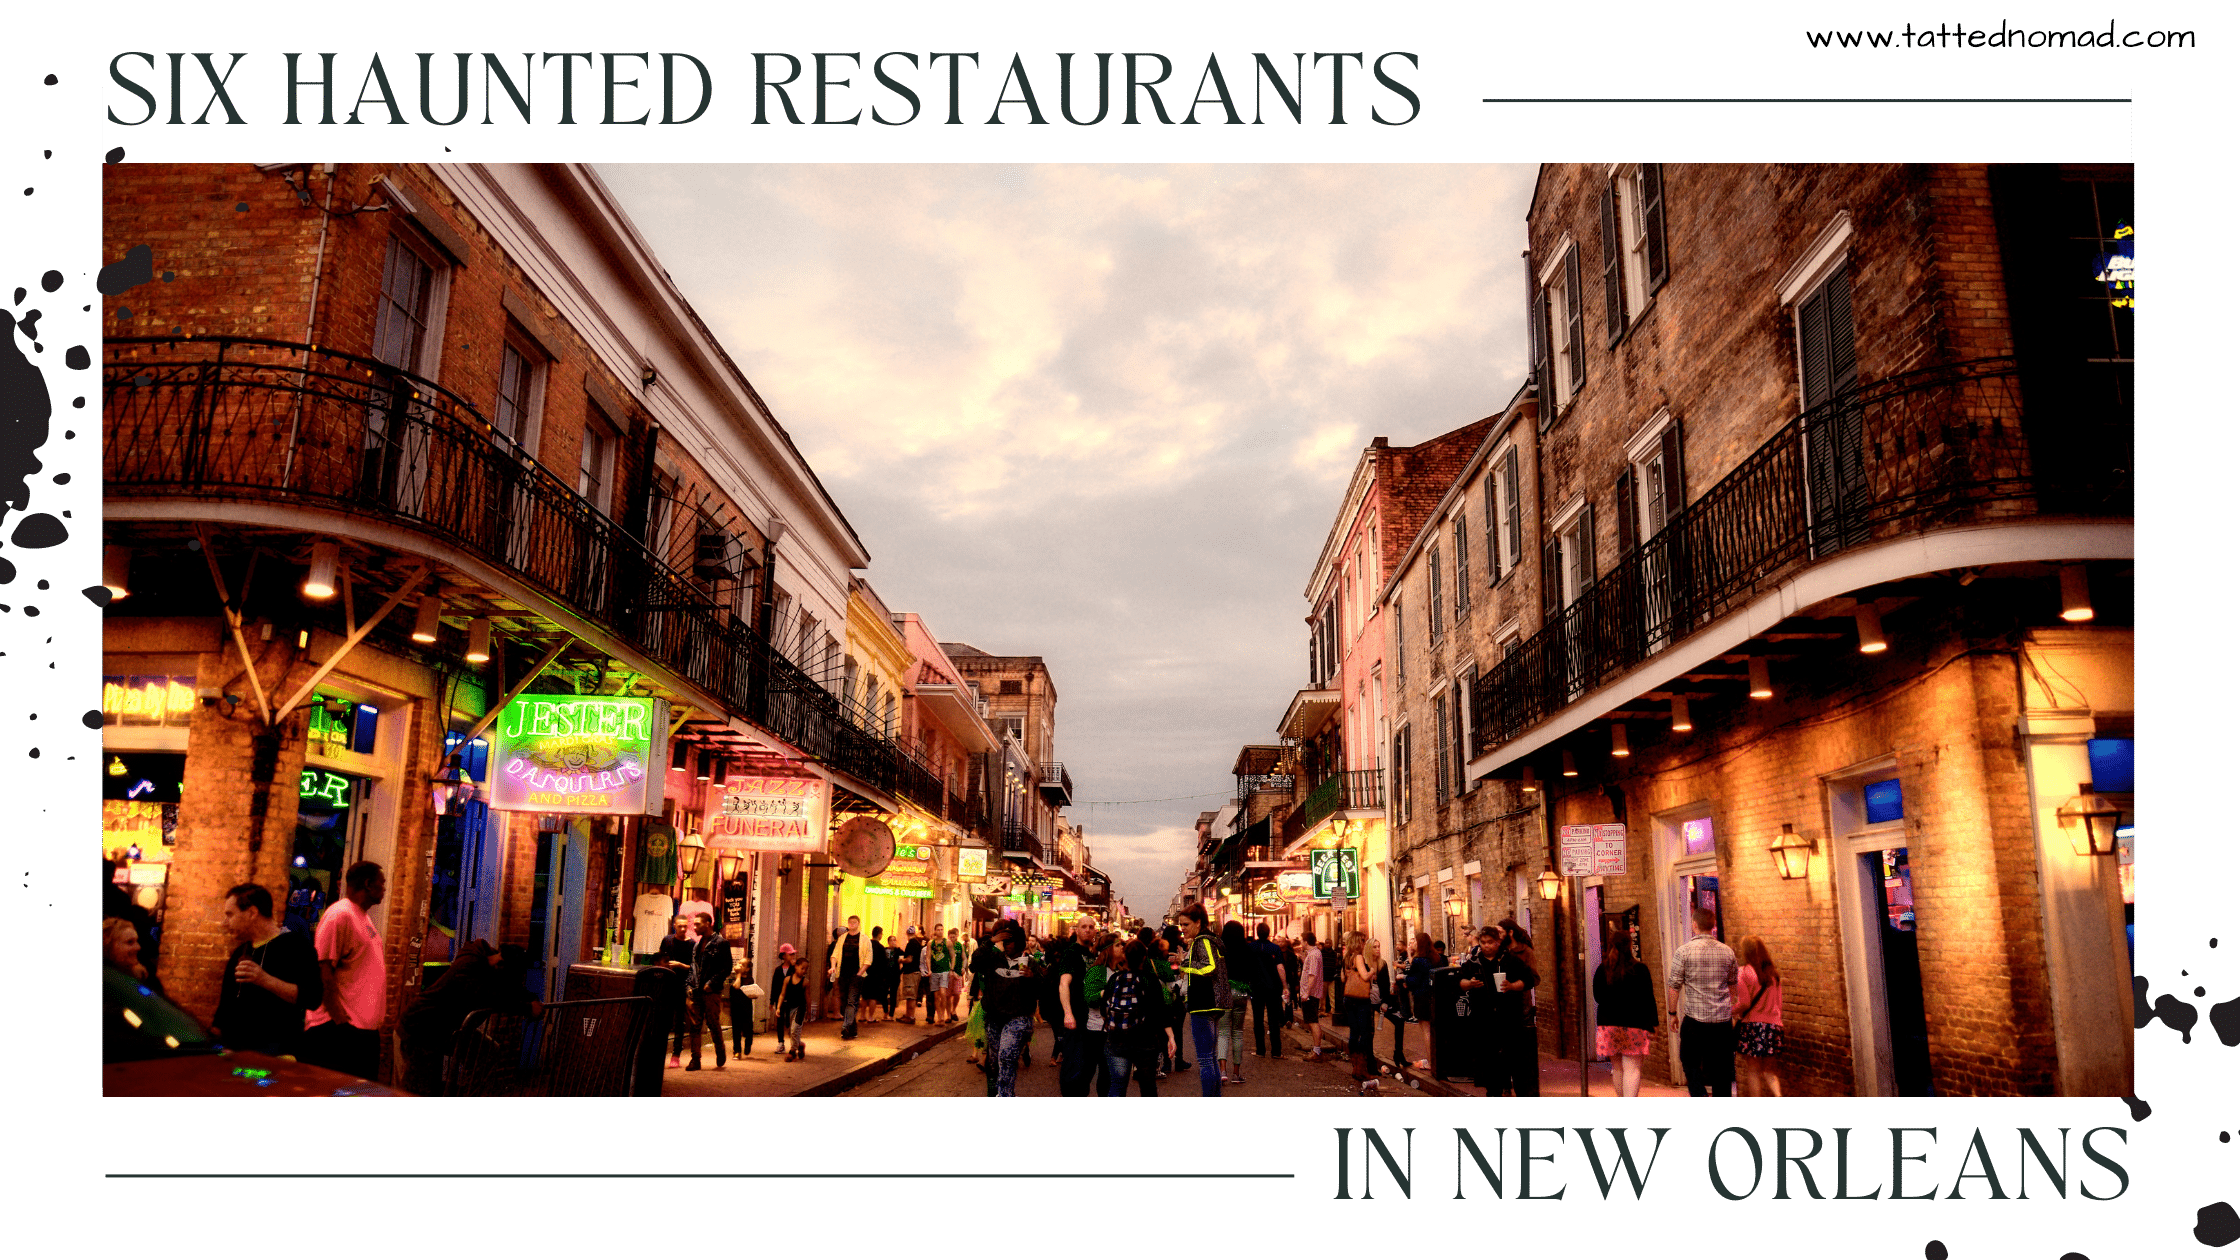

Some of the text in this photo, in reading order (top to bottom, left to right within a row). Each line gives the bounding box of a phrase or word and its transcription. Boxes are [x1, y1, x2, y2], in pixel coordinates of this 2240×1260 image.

[506, 700, 649, 741] JESTER
[539, 735, 614, 749] MARDI GRAS
[506, 758, 642, 794] DAIQUIRIS
[727, 779, 805, 796] JAZZ
[528, 792, 608, 806] AND PIZZA
[711, 816, 815, 838] FUNERAL
[1602, 829, 1624, 837] STOPPING
[1313, 851, 1334, 875] BEER
[1597, 864, 1624, 872] ANYTIME
